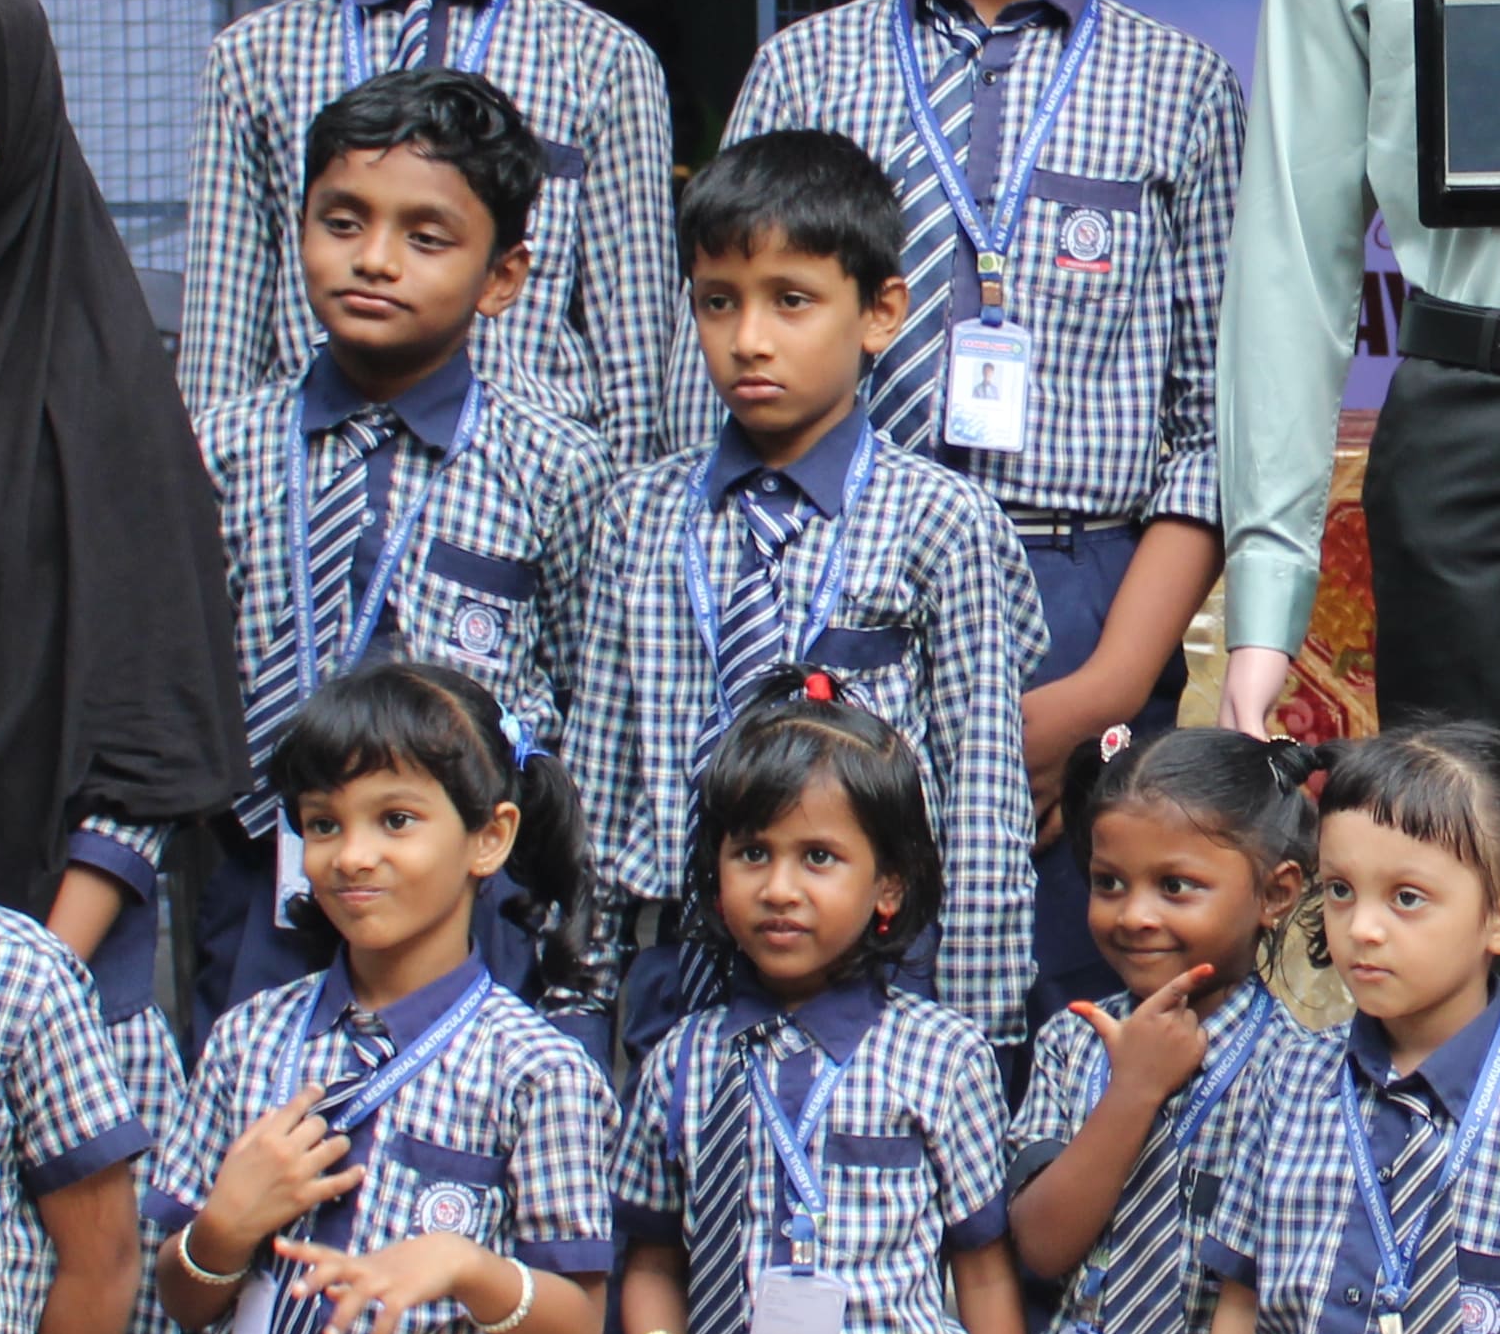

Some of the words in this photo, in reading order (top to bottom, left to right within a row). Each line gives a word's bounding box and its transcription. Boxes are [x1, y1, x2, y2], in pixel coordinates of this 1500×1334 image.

[363, 1055, 419, 1105] MEMORIAL
[415, 992, 481, 1060] MATRICULATION
[1201, 1023, 1258, 1099] MATRICULATION
[788, 1152, 815, 1195] ABDUL
[1452, 1124, 1480, 1173] SCHOOL
